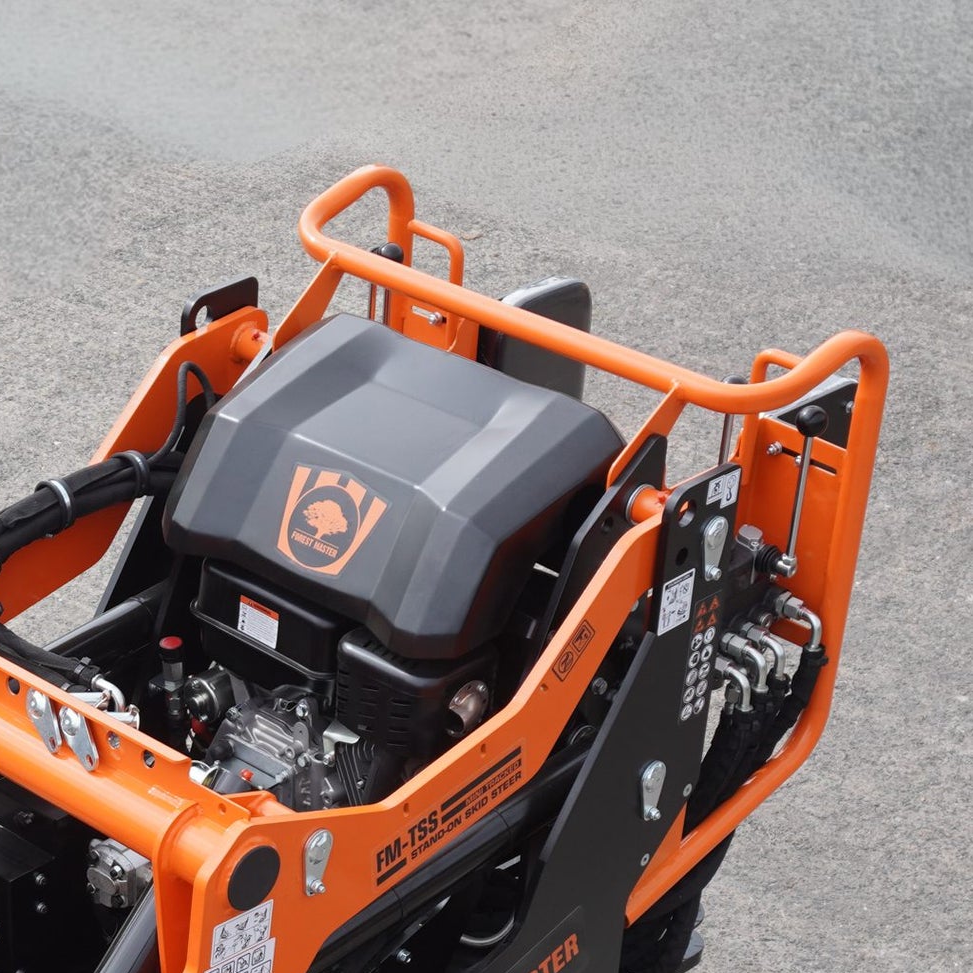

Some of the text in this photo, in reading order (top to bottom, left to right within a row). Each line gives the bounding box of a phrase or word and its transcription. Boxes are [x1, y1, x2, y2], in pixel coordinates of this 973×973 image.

[291, 530, 338, 558] FOREST MASTER
[376, 810, 439, 873] FM-TSS
[411, 771, 521, 859] STAND-ON SKID STEER
